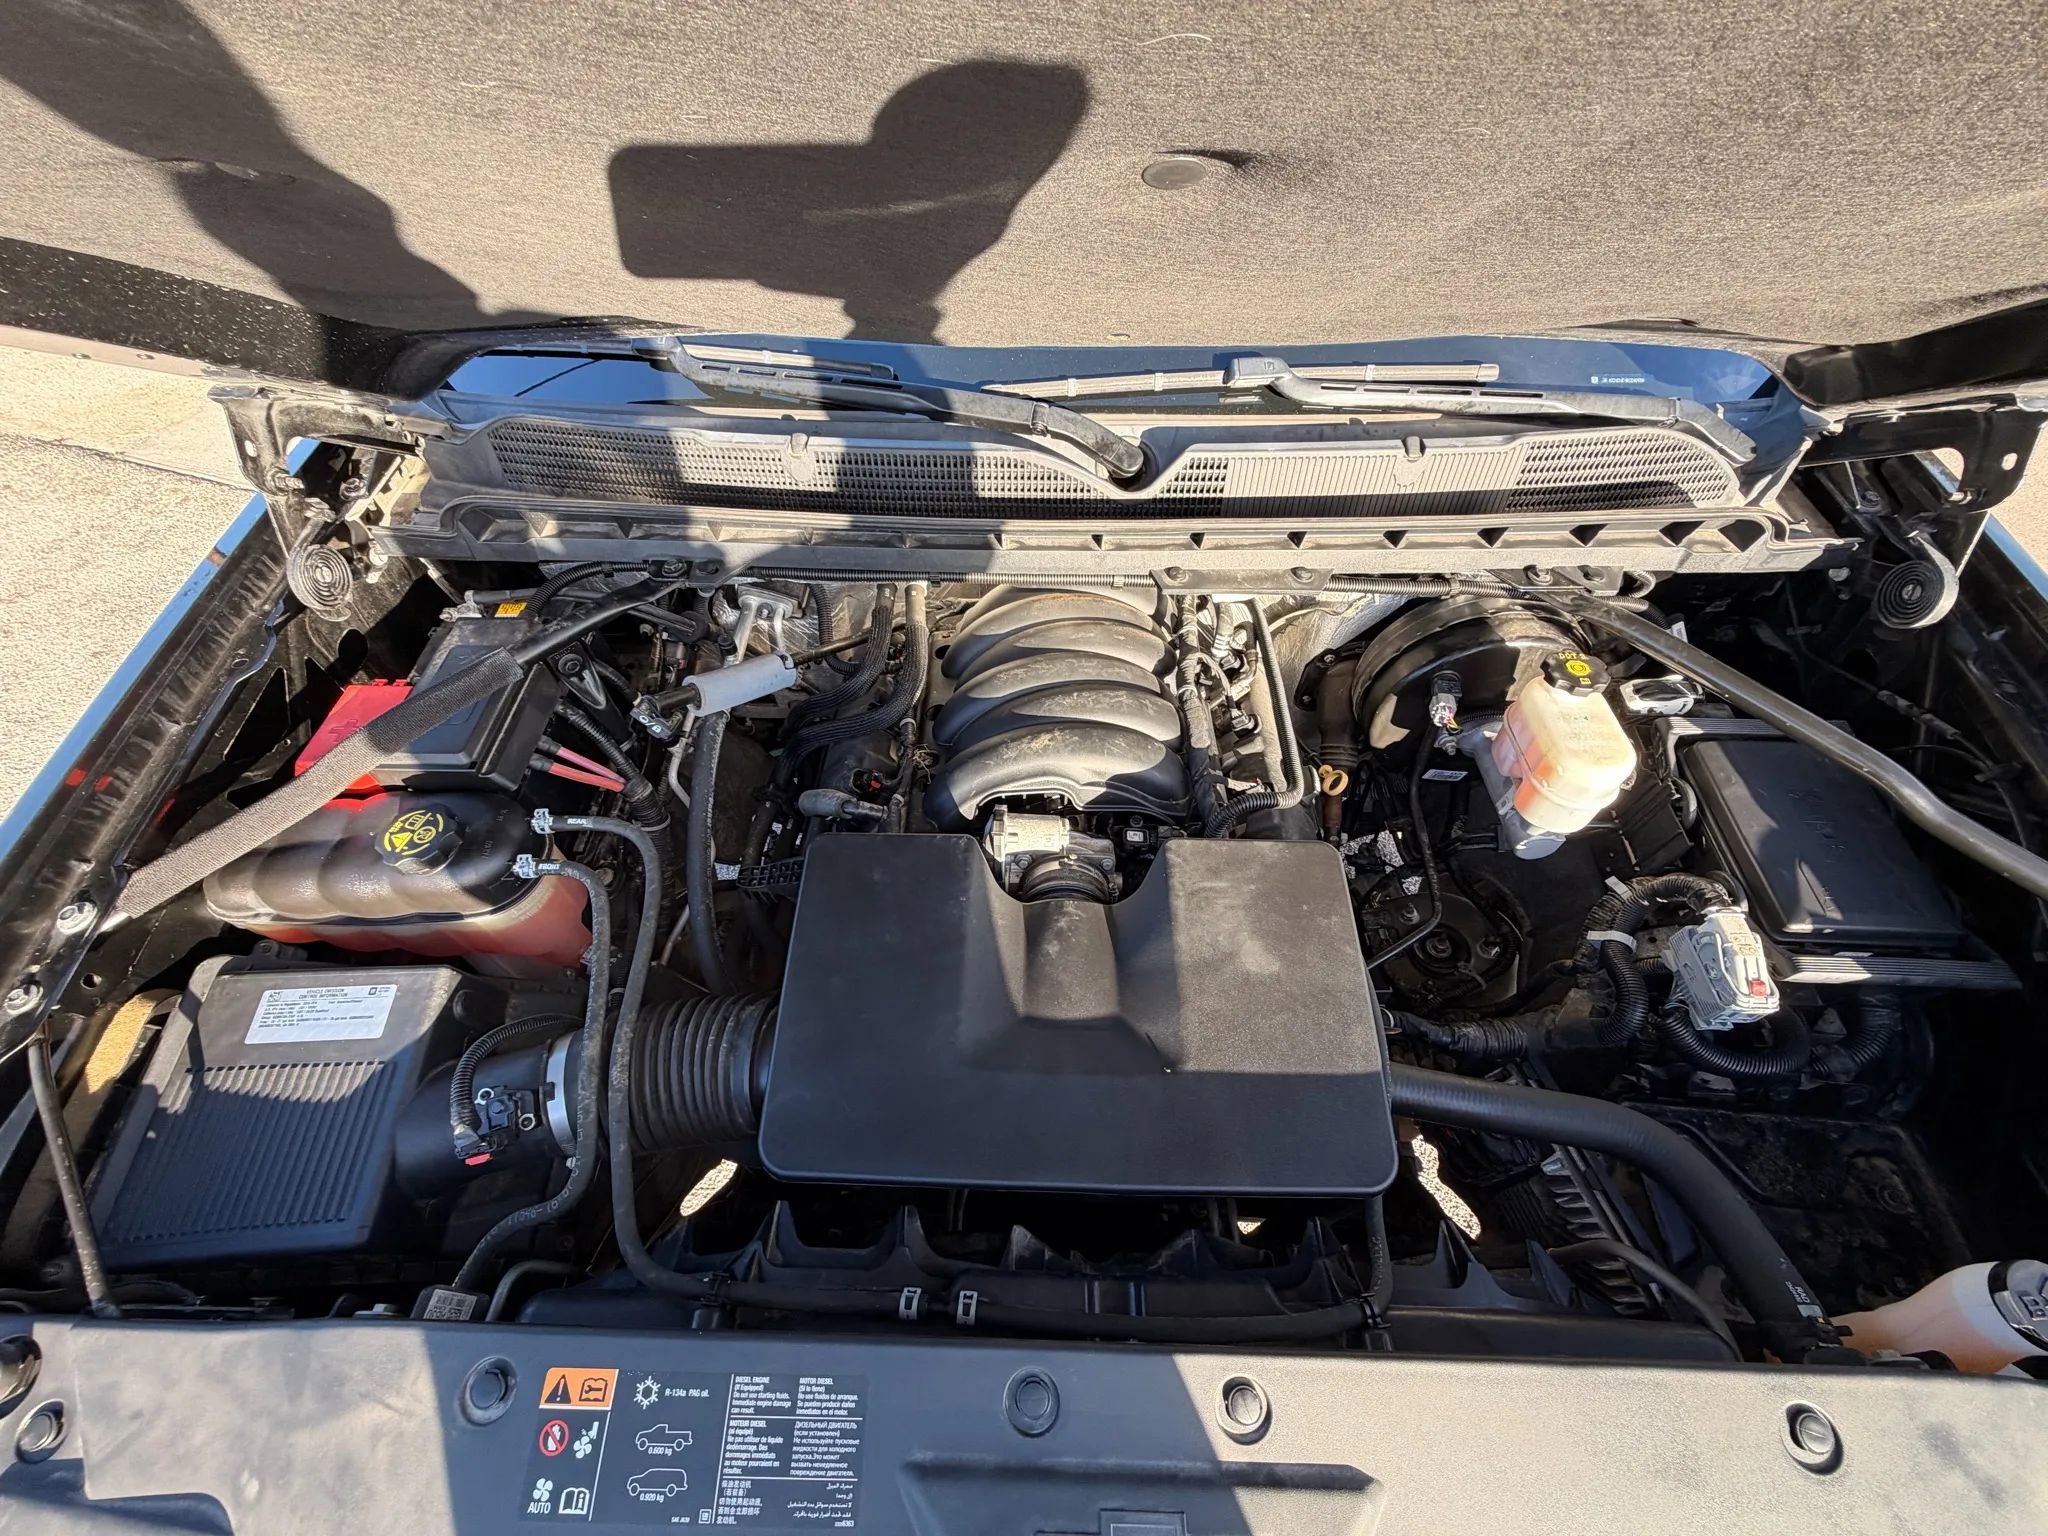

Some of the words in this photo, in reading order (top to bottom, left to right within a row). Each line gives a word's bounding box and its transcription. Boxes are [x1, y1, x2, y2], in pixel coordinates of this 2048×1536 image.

[665, 1388, 686, 1396] R-134a
[758, 1392, 775, 1400] starting
[665, 1447, 672, 1456] kg
[657, 1494, 664, 1503] kg
[527, 1502, 551, 1513] AUTO
